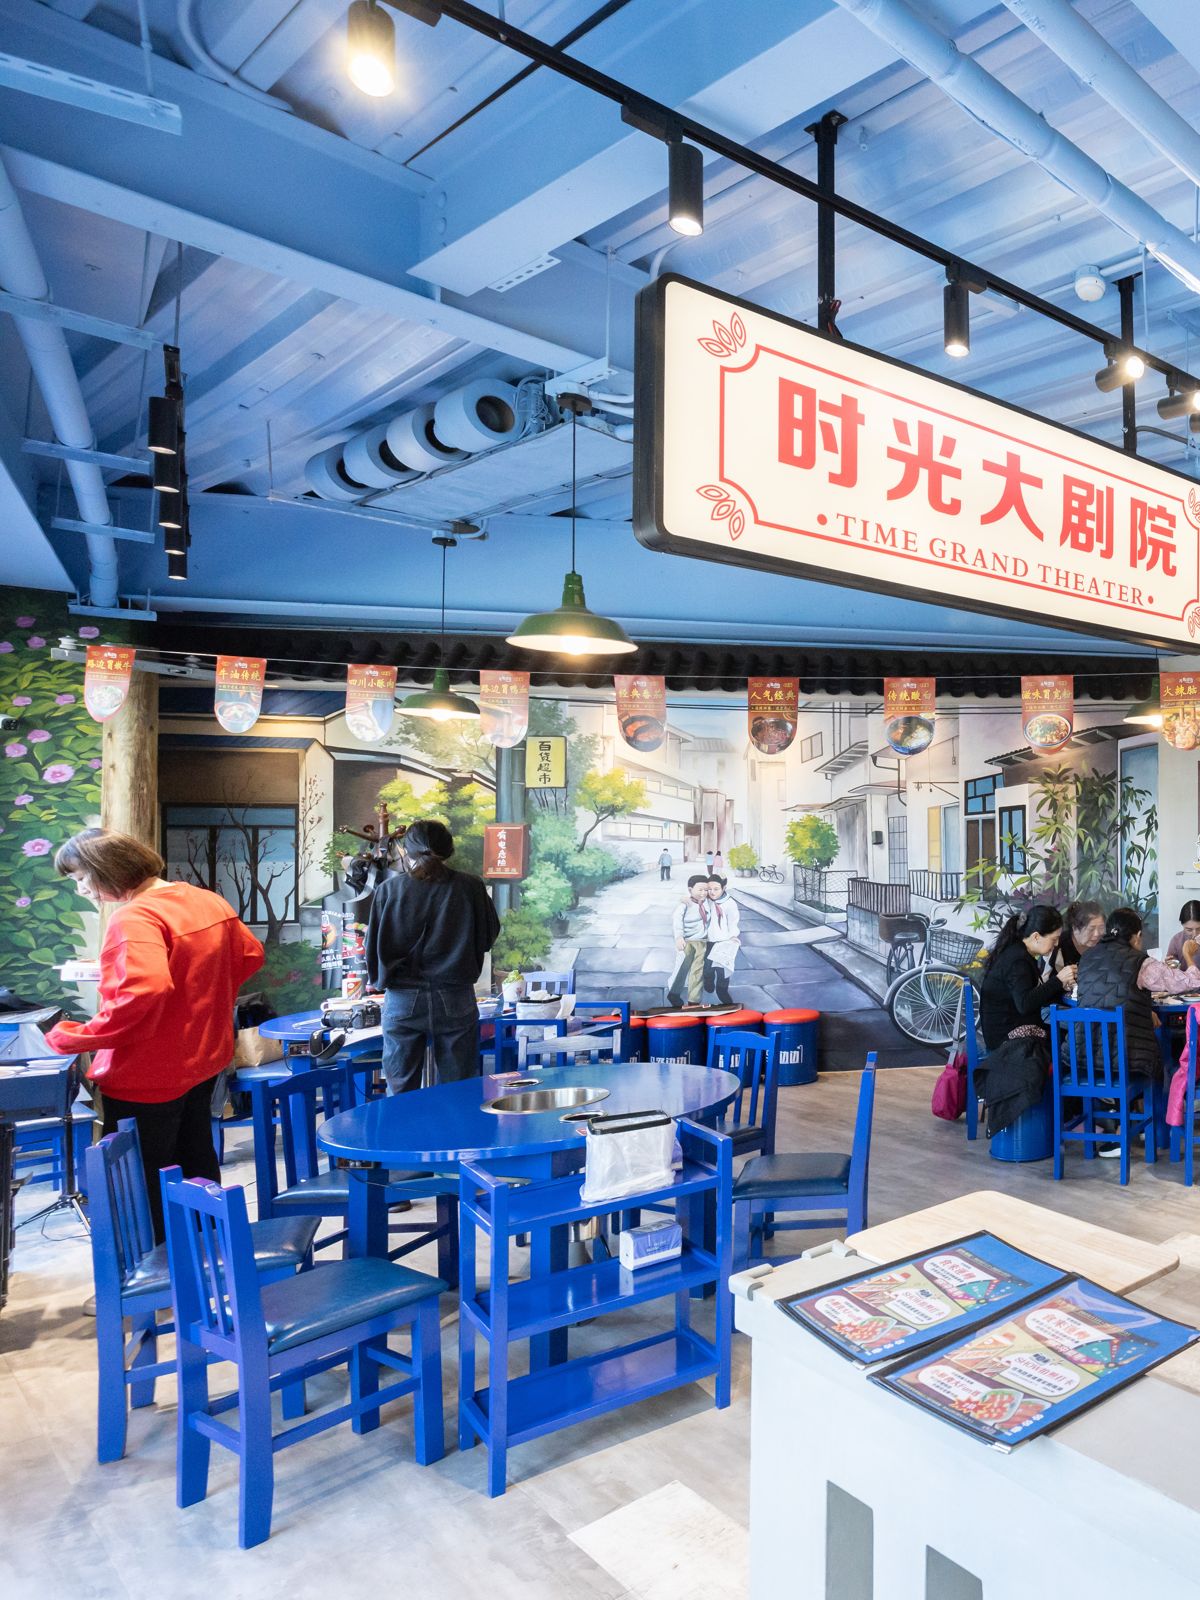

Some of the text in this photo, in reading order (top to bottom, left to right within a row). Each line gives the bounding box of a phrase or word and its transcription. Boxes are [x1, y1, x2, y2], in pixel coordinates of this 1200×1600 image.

[778, 376, 1177, 577] 时光大剧院
[836, 513, 1144, 606] TIME GRAND THEATER
[751, 690, 796, 701] 人气经典
[537, 740, 552, 784] 百货超市
